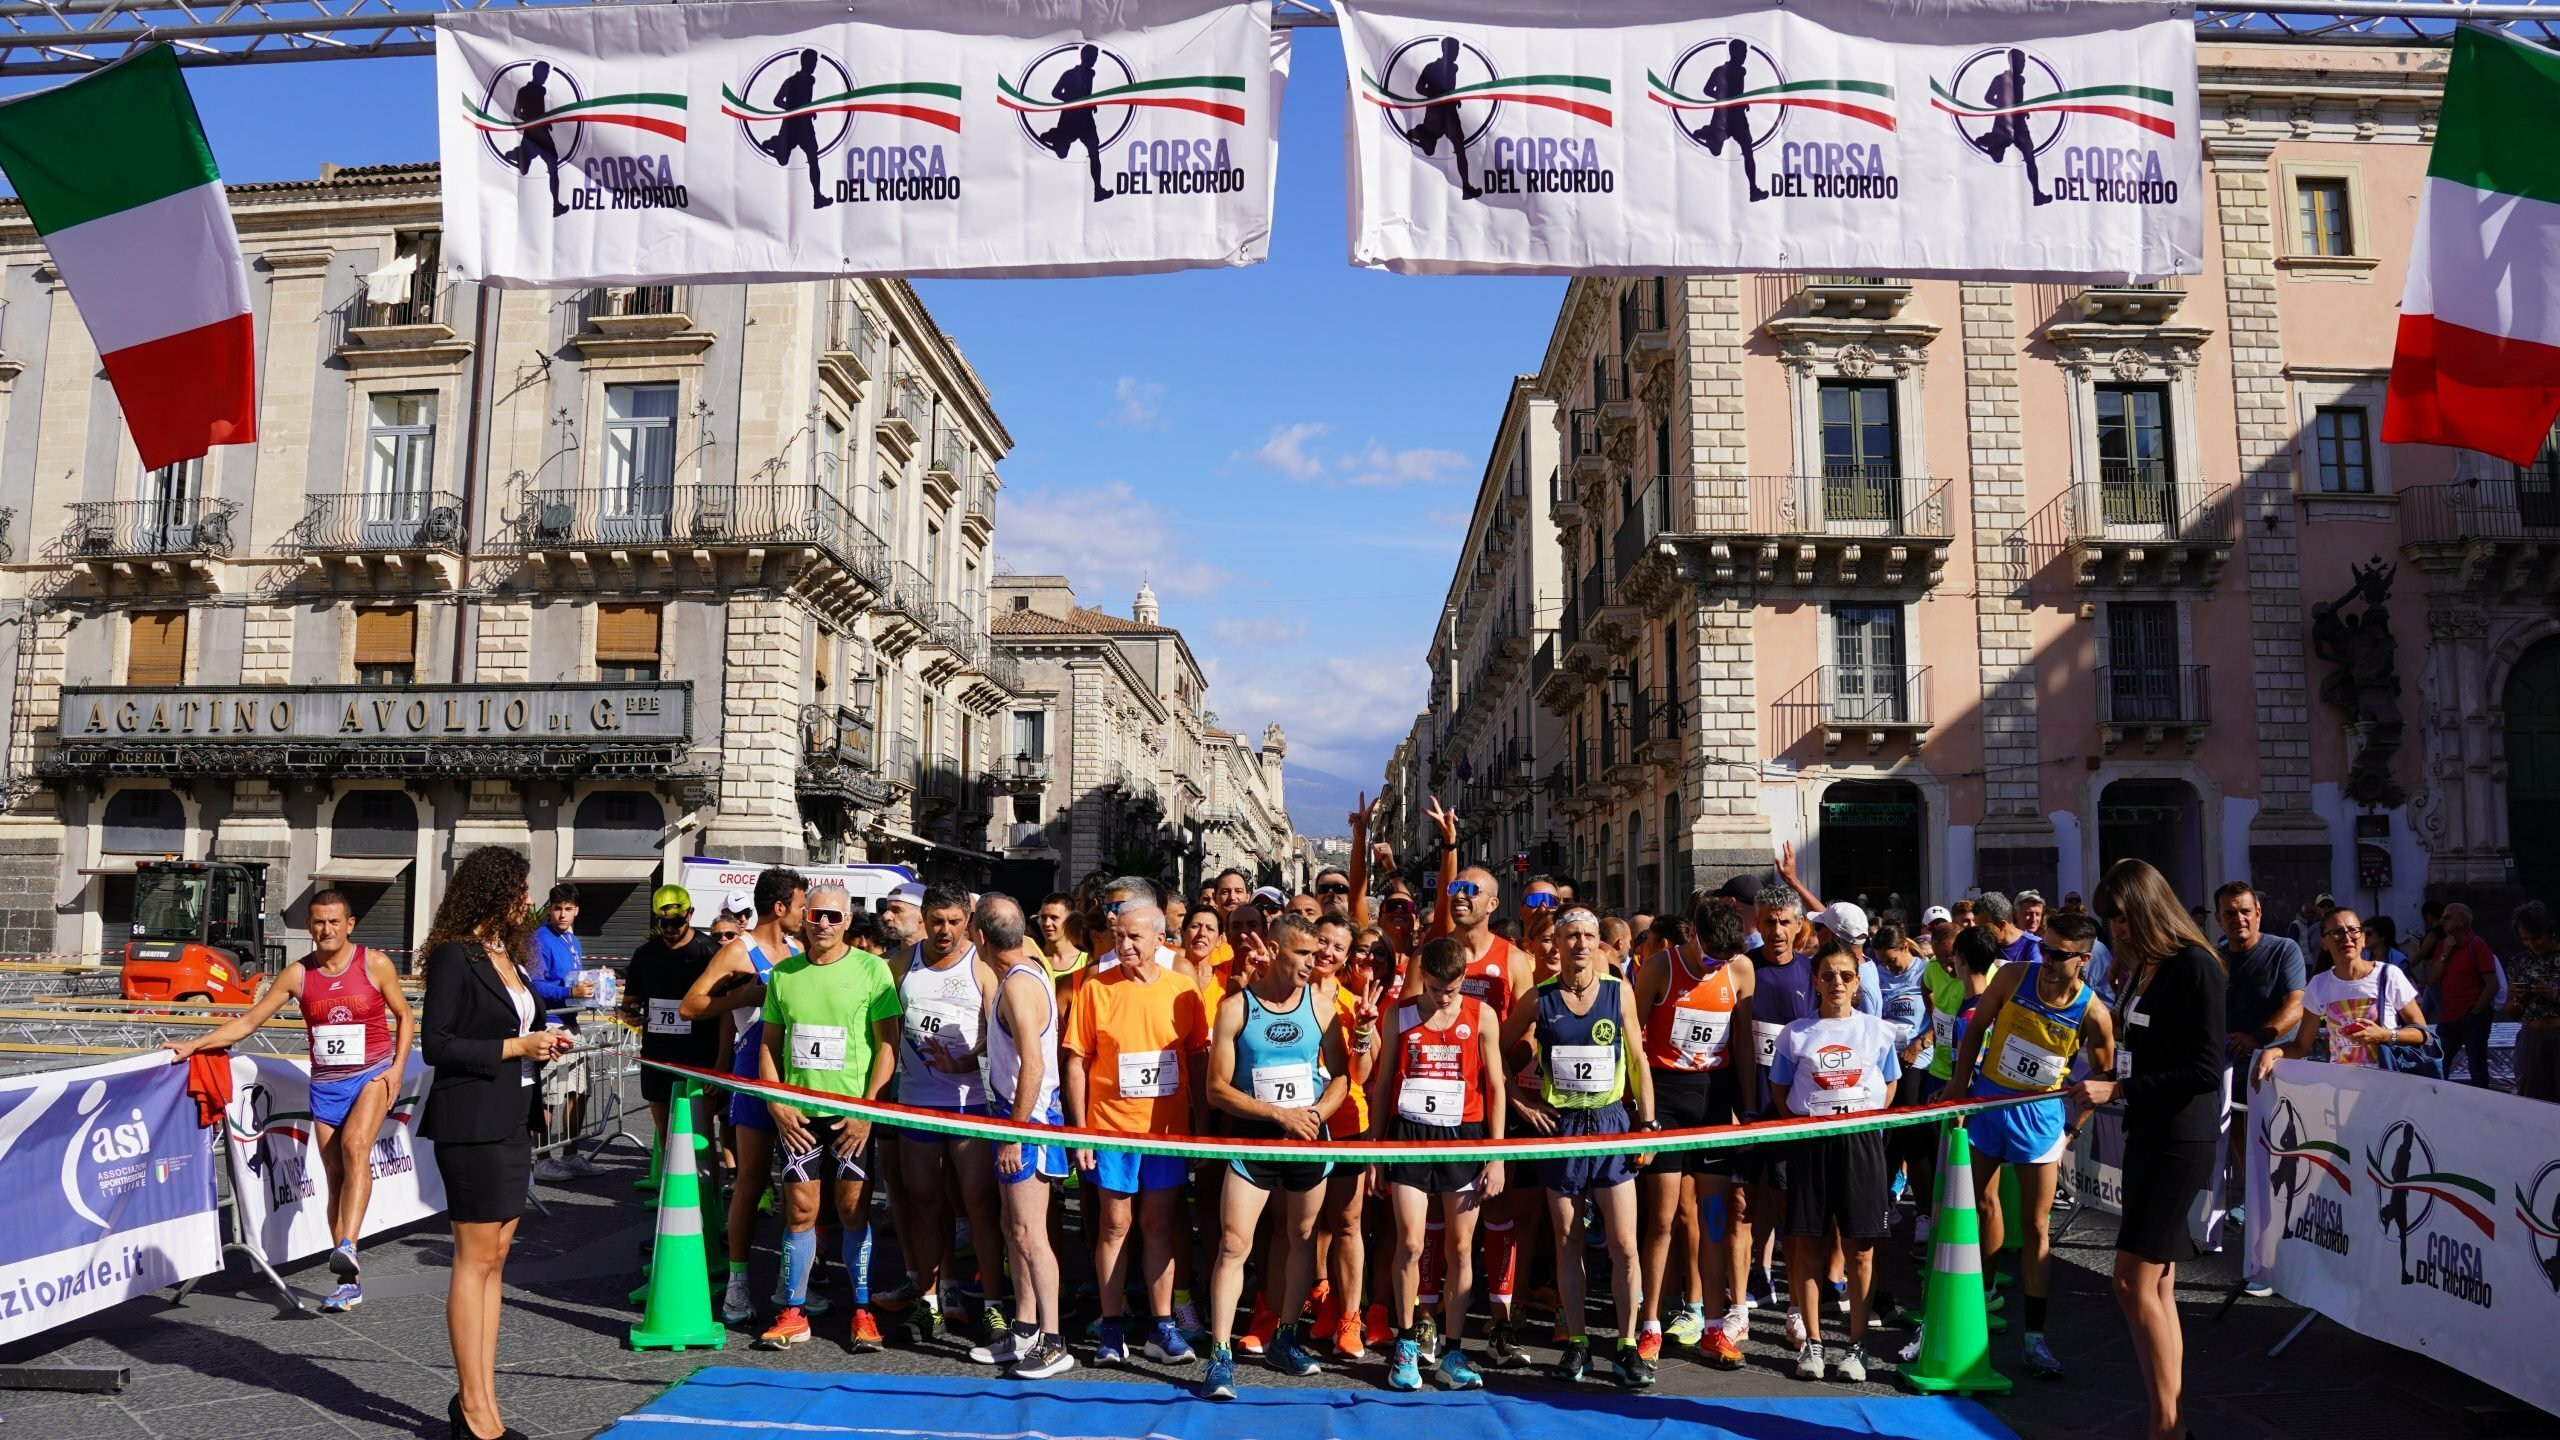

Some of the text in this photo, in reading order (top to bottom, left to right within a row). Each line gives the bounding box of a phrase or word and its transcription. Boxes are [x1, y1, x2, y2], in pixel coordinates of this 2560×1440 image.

[847, 144, 946, 184] CORSA
[1128, 138, 1231, 177] CORSA
[1494, 136, 1601, 174] CORSA
[1782, 141, 1885, 180] CORSA
[2064, 146, 2163, 184] CORSA
[583, 154, 674, 191] CORSA
[1116, 168, 1245, 196] DEL RICORDO
[1484, 169, 1614, 194] DEL RICORDO
[571, 184, 689, 211] DEL RICORDO
[836, 176, 960, 203] DEL RICORDO
[1771, 173, 1898, 200] DEL RICORDO
[2055, 177, 2178, 204] DEL RICORDO
[84, 700, 294, 733] AGATINO
[339, 698, 529, 733] AVOLIO
[548, 712, 572, 730] DI
[719, 873, 845, 888] CROCE ALIANA
[139, 950, 169, 958] MANITOU
[660, 1012, 675, 1024] 78
[921, 1015, 941, 1033] 46
[1937, 1022, 1945, 1037] 55
[1691, 1026, 1712, 1042] 56
[327, 1039, 345, 1055] 52
[810, 1042, 820, 1057] 4
[1574, 1063, 1592, 1079] 12
[1819, 1051, 1852, 1069] IGP
[2017, 1056, 2039, 1077] 58
[1141, 1068, 1160, 1085] 37
[1275, 1083, 1295, 1100] 79
[1425, 1096, 1436, 1112] 5
[92, 1108, 150, 1163] asi
[370, 1155, 412, 1180] EL RICORDO
[102, 1179, 146, 1198] ITALIANE
[279, 1185, 294, 1205] DEL
[2304, 1193, 2344, 1234] CORSA
[2295, 1218, 2349, 1257] DEL RICORDO
[2427, 1230, 2483, 1283] CORSA
[2416, 1259, 2492, 1309] DEL RICORDO
